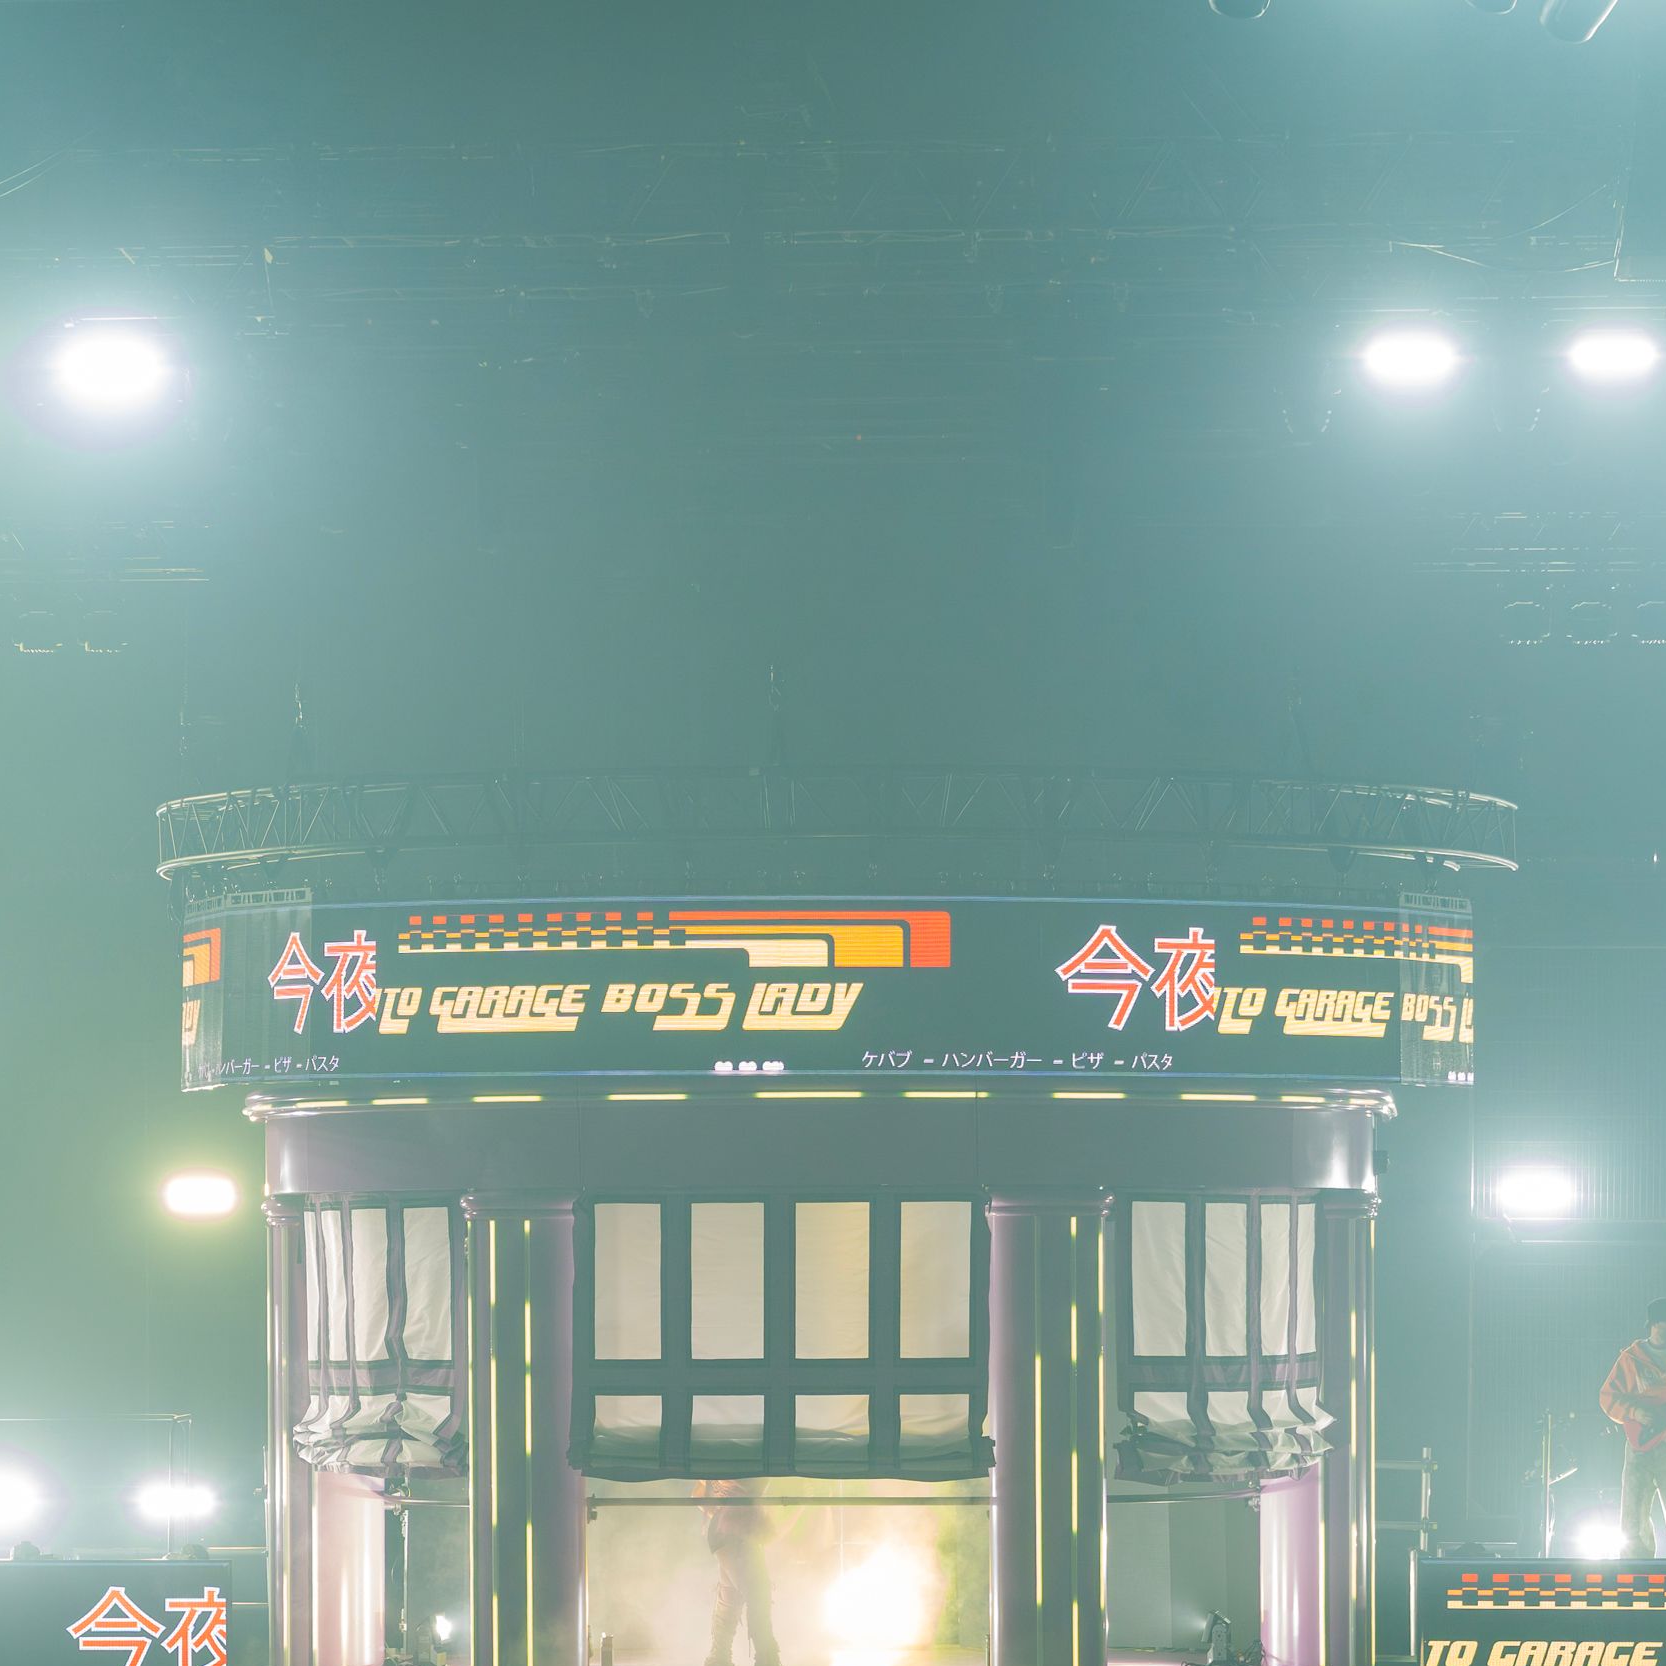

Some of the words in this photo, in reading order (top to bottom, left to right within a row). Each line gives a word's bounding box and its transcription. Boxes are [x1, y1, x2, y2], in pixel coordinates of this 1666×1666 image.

[268, 930, 376, 1034] 今夜
[1055, 925, 1215, 1031] 今夜
[376, 988, 422, 1034] TO
[429, 985, 590, 1033] GARAGE
[601, 984, 735, 1030] BOSS
[743, 983, 863, 1030] LADY
[1215, 987, 1266, 1034] TO
[1275, 989, 1394, 1037] GARAGE
[1401, 993, 1456, 1041] BOSS
[306, 1056, 339, 1071] パスタ
[862, 1050, 912, 1067] ケバブ
[942, 1051, 1042, 1068] ハンバーガー
[1073, 1053, 1104, 1069] ピザ
[1132, 1052, 1172, 1070] パスタ
